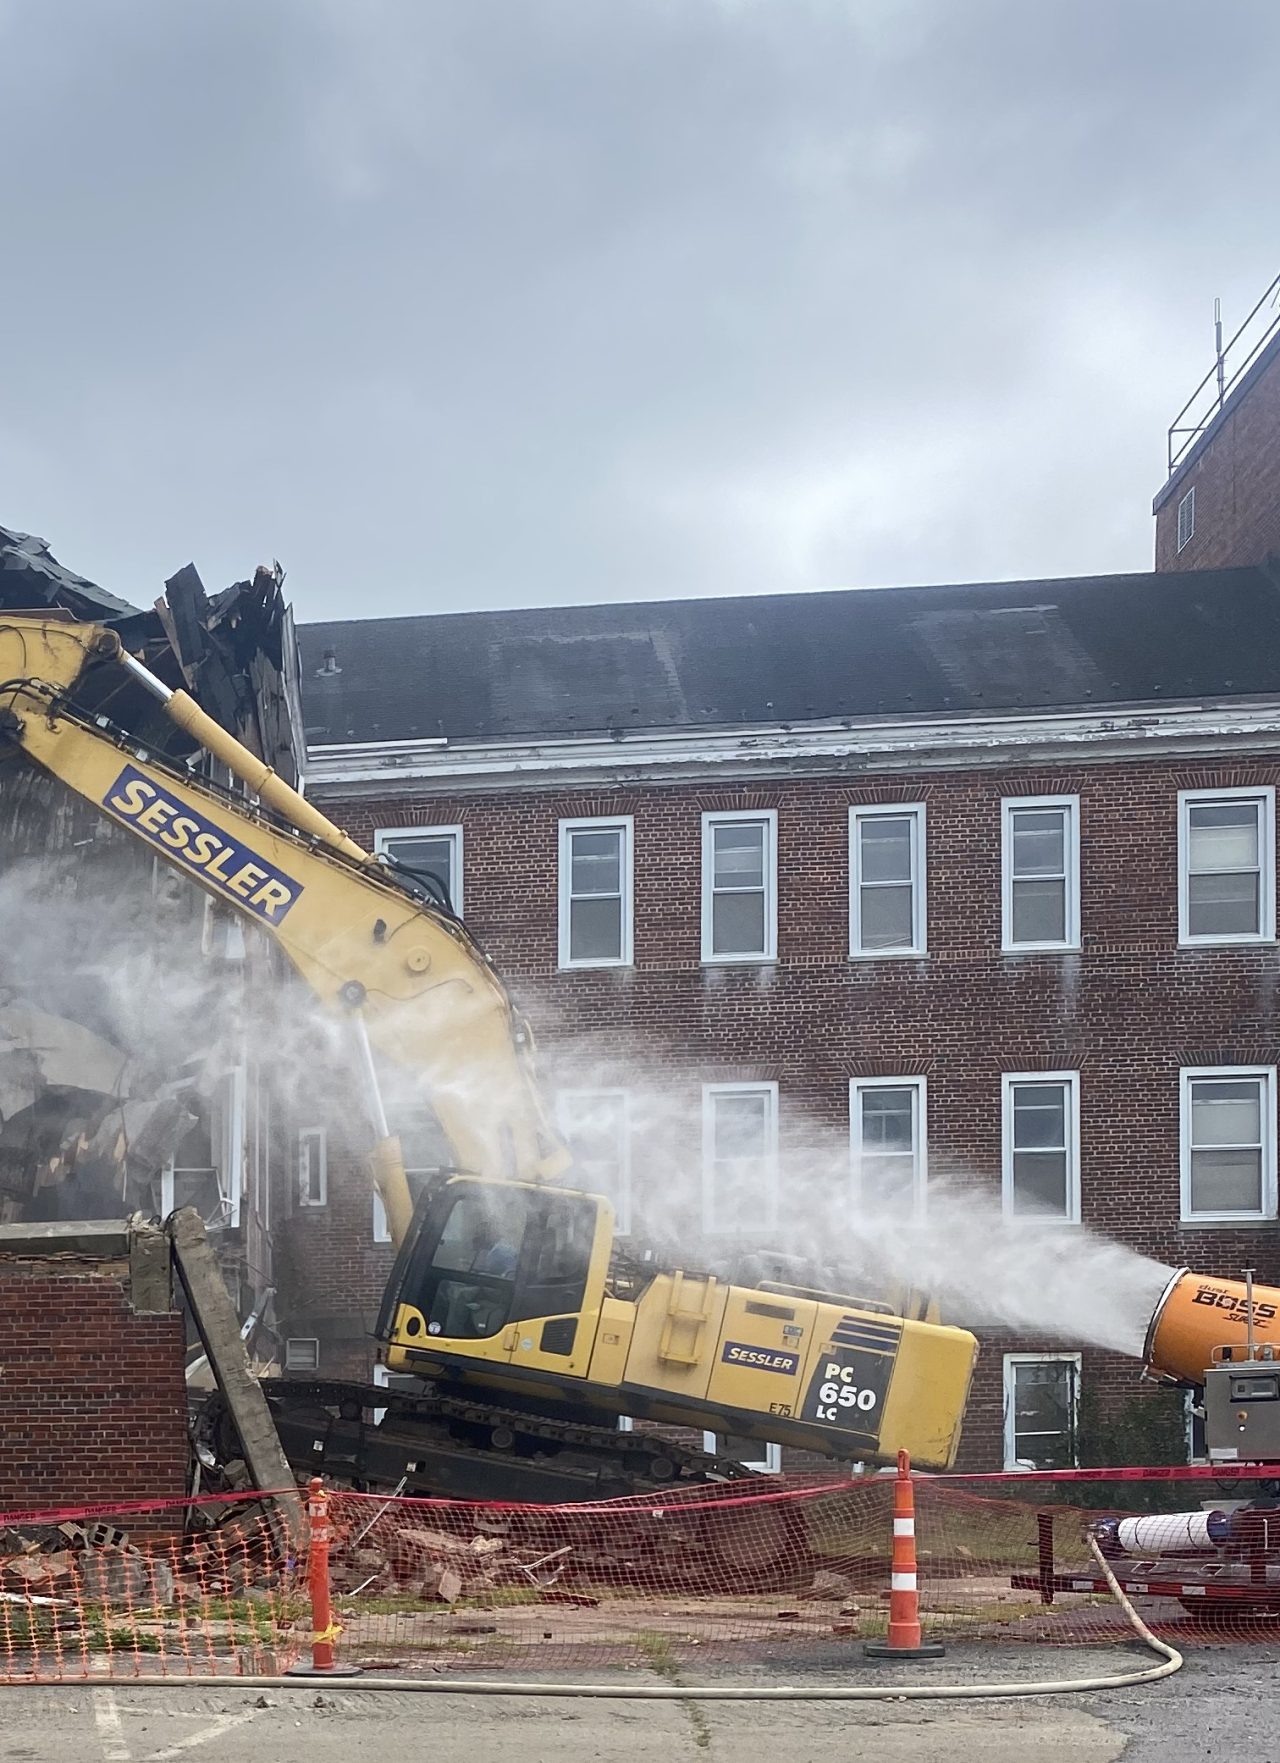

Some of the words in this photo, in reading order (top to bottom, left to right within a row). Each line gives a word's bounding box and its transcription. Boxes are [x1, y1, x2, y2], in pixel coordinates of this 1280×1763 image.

[111, 780, 292, 916] SESSLER
[1192, 1290, 1278, 1318] BOSS
[727, 1347, 793, 1371] SESSLER
[825, 1363, 854, 1383] PC
[819, 1382, 876, 1411] 650
[816, 1405, 837, 1421] LC
